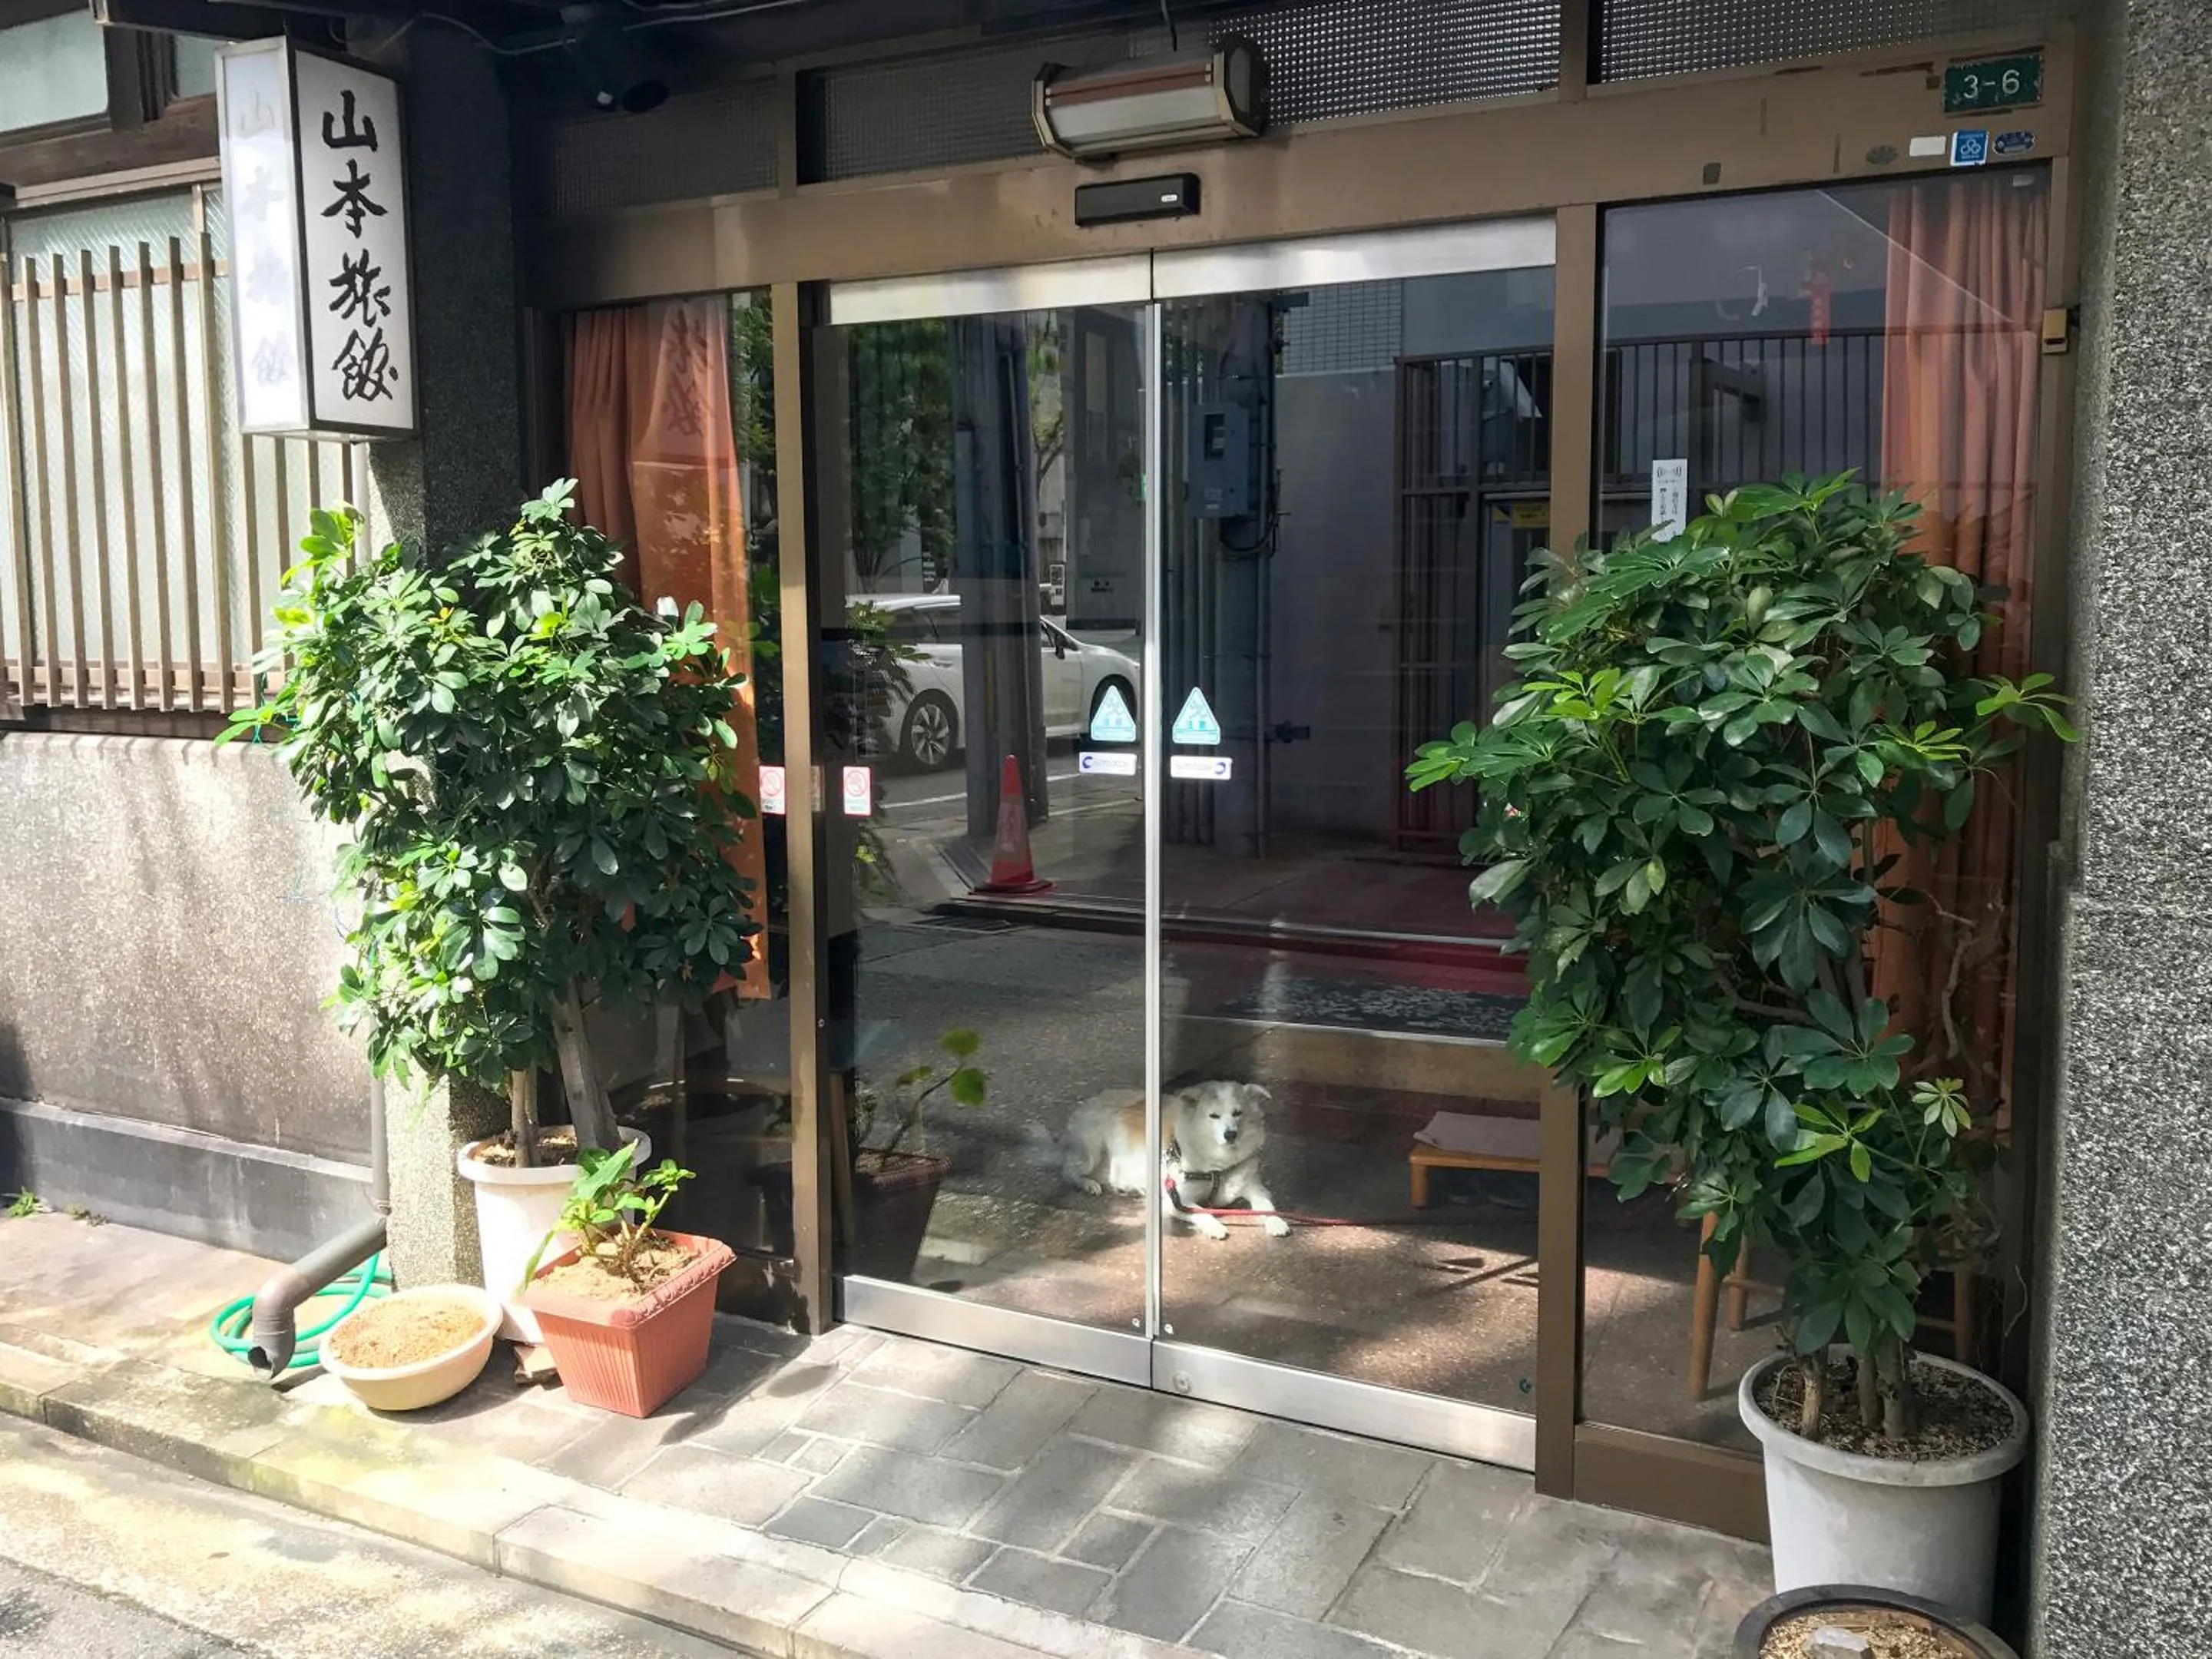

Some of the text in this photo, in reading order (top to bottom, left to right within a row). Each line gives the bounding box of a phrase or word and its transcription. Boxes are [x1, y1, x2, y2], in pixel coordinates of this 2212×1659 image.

[1963, 69, 2020, 99] 3-6
[321, 90, 399, 401] 山本旅館
